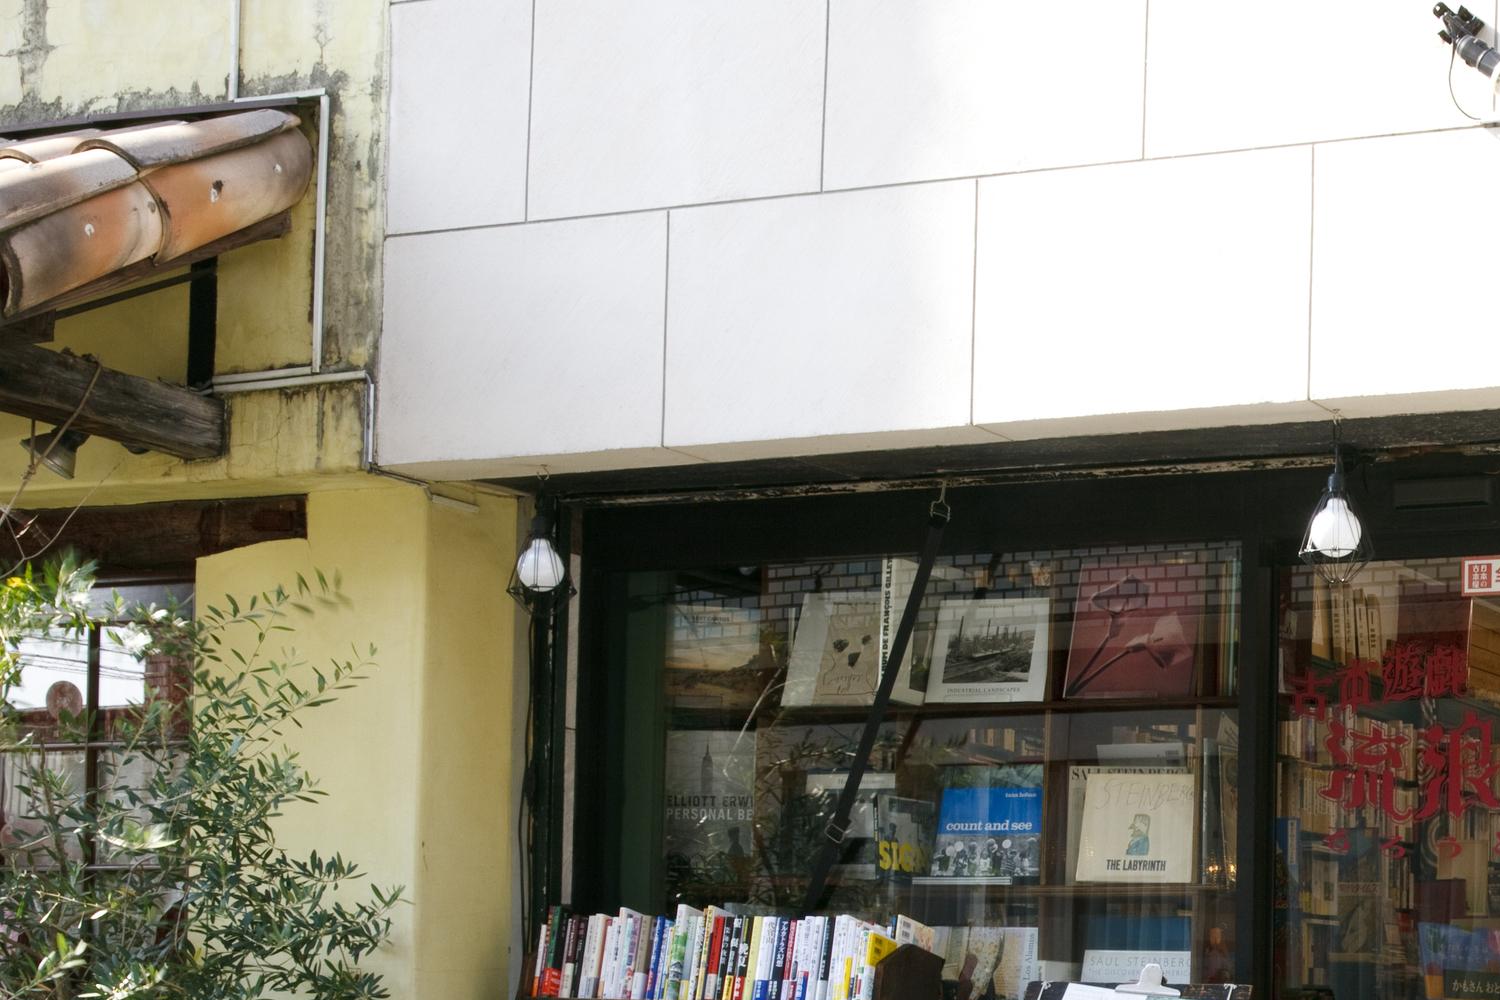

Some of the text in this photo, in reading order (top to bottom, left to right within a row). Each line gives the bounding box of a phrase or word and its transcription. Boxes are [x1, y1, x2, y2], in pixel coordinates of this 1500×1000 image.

[1288, 641, 1469, 724] 古本遊戯
[667, 795, 716, 807] ELLIOTT
[666, 808, 732, 821] PERSONAL
[946, 821, 1033, 832] count and see
[1106, 859, 1167, 871] THE LABYRINTH
[1022, 932, 1036, 981] Los Alamos
[1089, 956, 1120, 967] SAUL
[1088, 968, 1141, 976] THE DISCOVER
